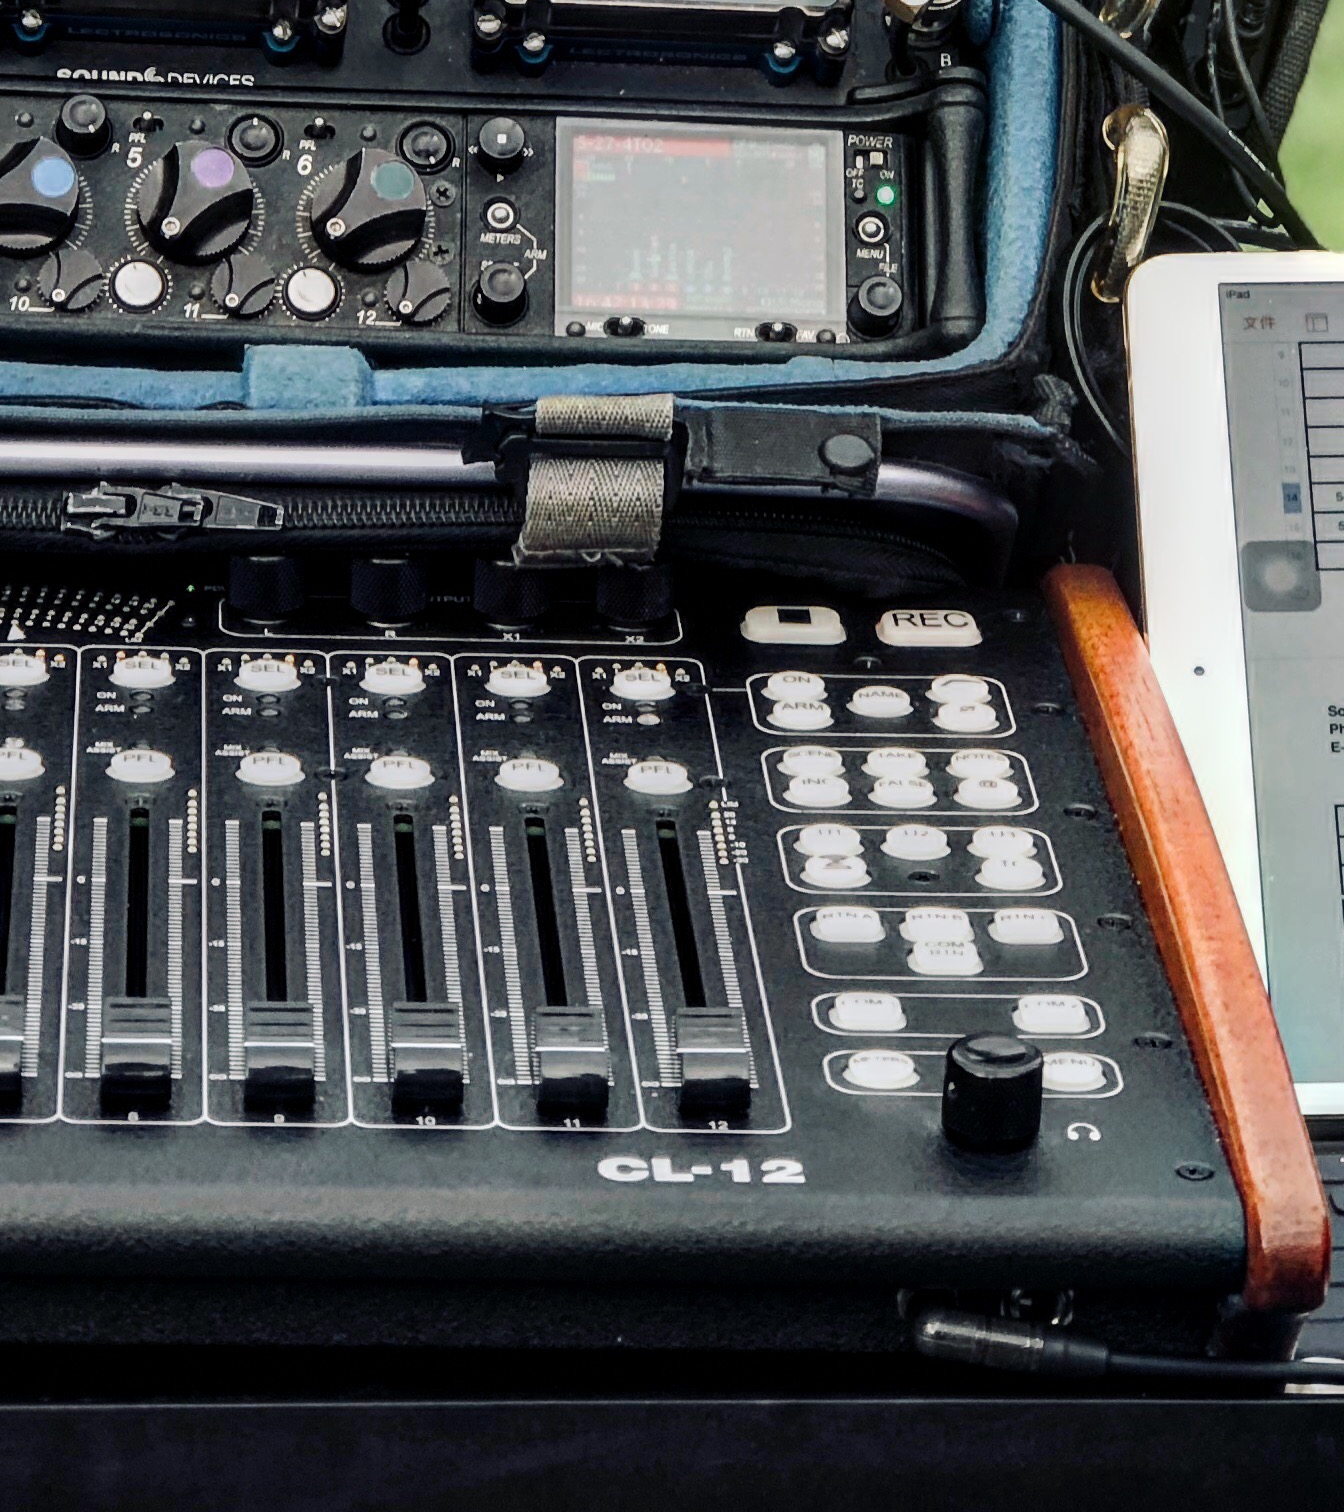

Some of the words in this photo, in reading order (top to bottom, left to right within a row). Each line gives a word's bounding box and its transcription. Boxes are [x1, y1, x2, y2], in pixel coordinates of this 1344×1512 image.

[847, 133, 894, 149] POWER
[126, 146, 143, 168] 5
[297, 154, 313, 176] 6
[479, 232, 522, 246] METERS
[524, 248, 547, 261] ARM
[856, 247, 884, 260] MENU
[1225, 288, 1251, 300] iPad
[9, 295, 31, 312] 10
[357, 309, 377, 325] 12
[1242, 314, 1276, 331] 文件
[892, 611, 969, 629] REC
[858, 689, 905, 700] NAME
[782, 701, 825, 712] ARM
[597, 1157, 807, 1185] CL-12
